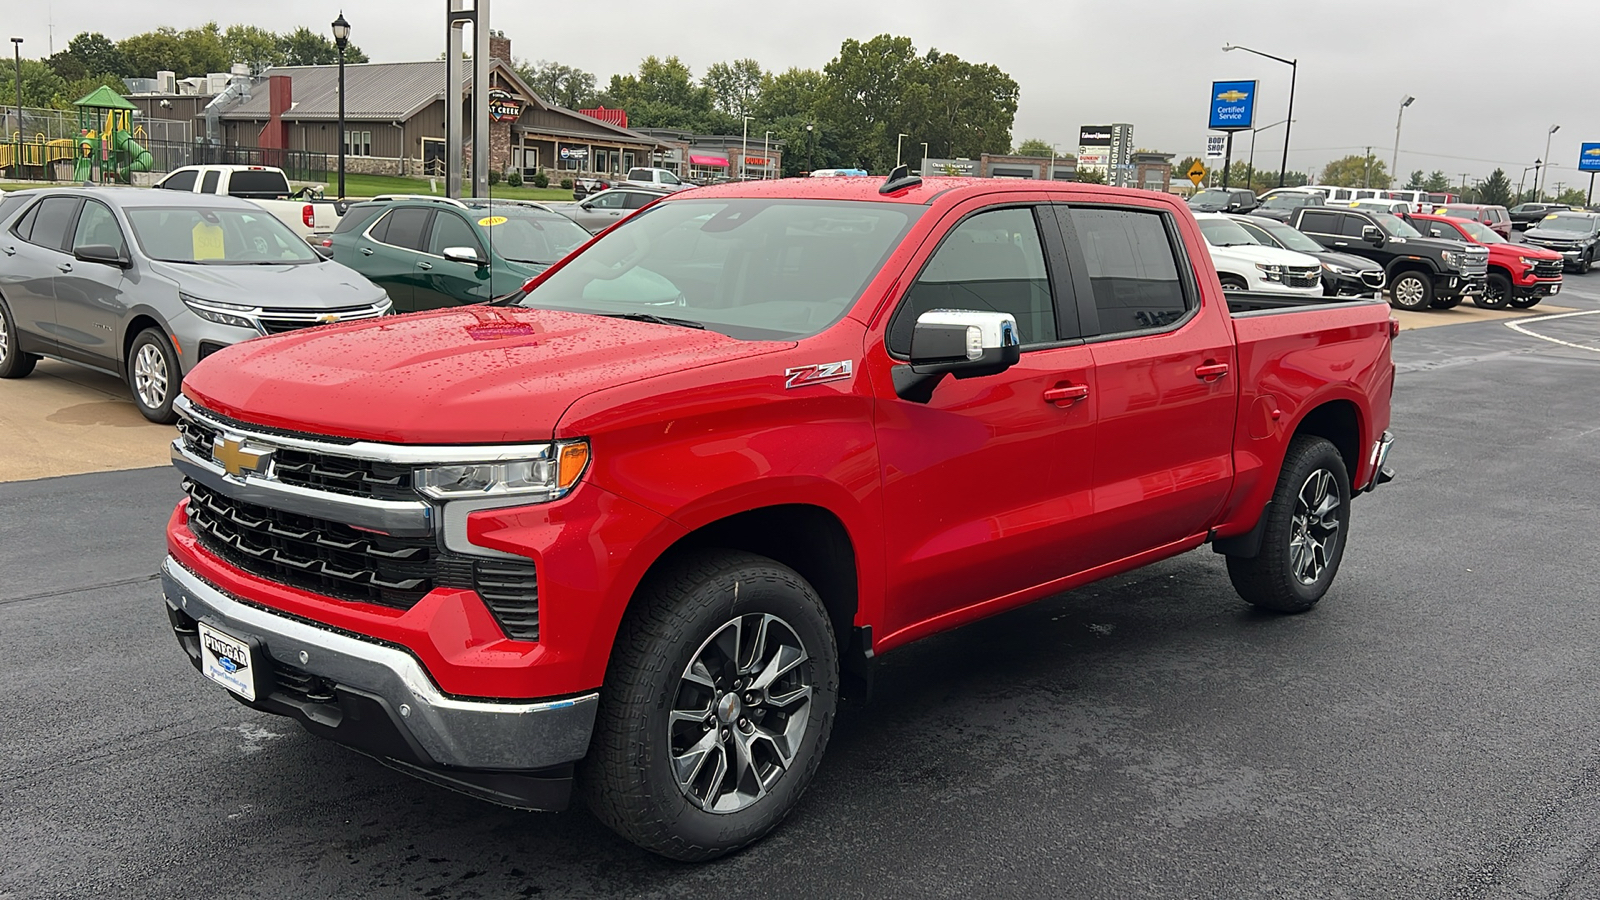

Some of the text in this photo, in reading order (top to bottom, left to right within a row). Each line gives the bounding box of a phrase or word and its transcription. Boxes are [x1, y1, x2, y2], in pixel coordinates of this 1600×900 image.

[498, 106, 519, 115] CREEK
[1110, 126, 1121, 169] WILDWOOD
[1124, 127, 1132, 165] WILDWOO
[198, 236, 221, 248] SOLD
[785, 360, 852, 389] Z71
[204, 634, 248, 666] PINEGAR
